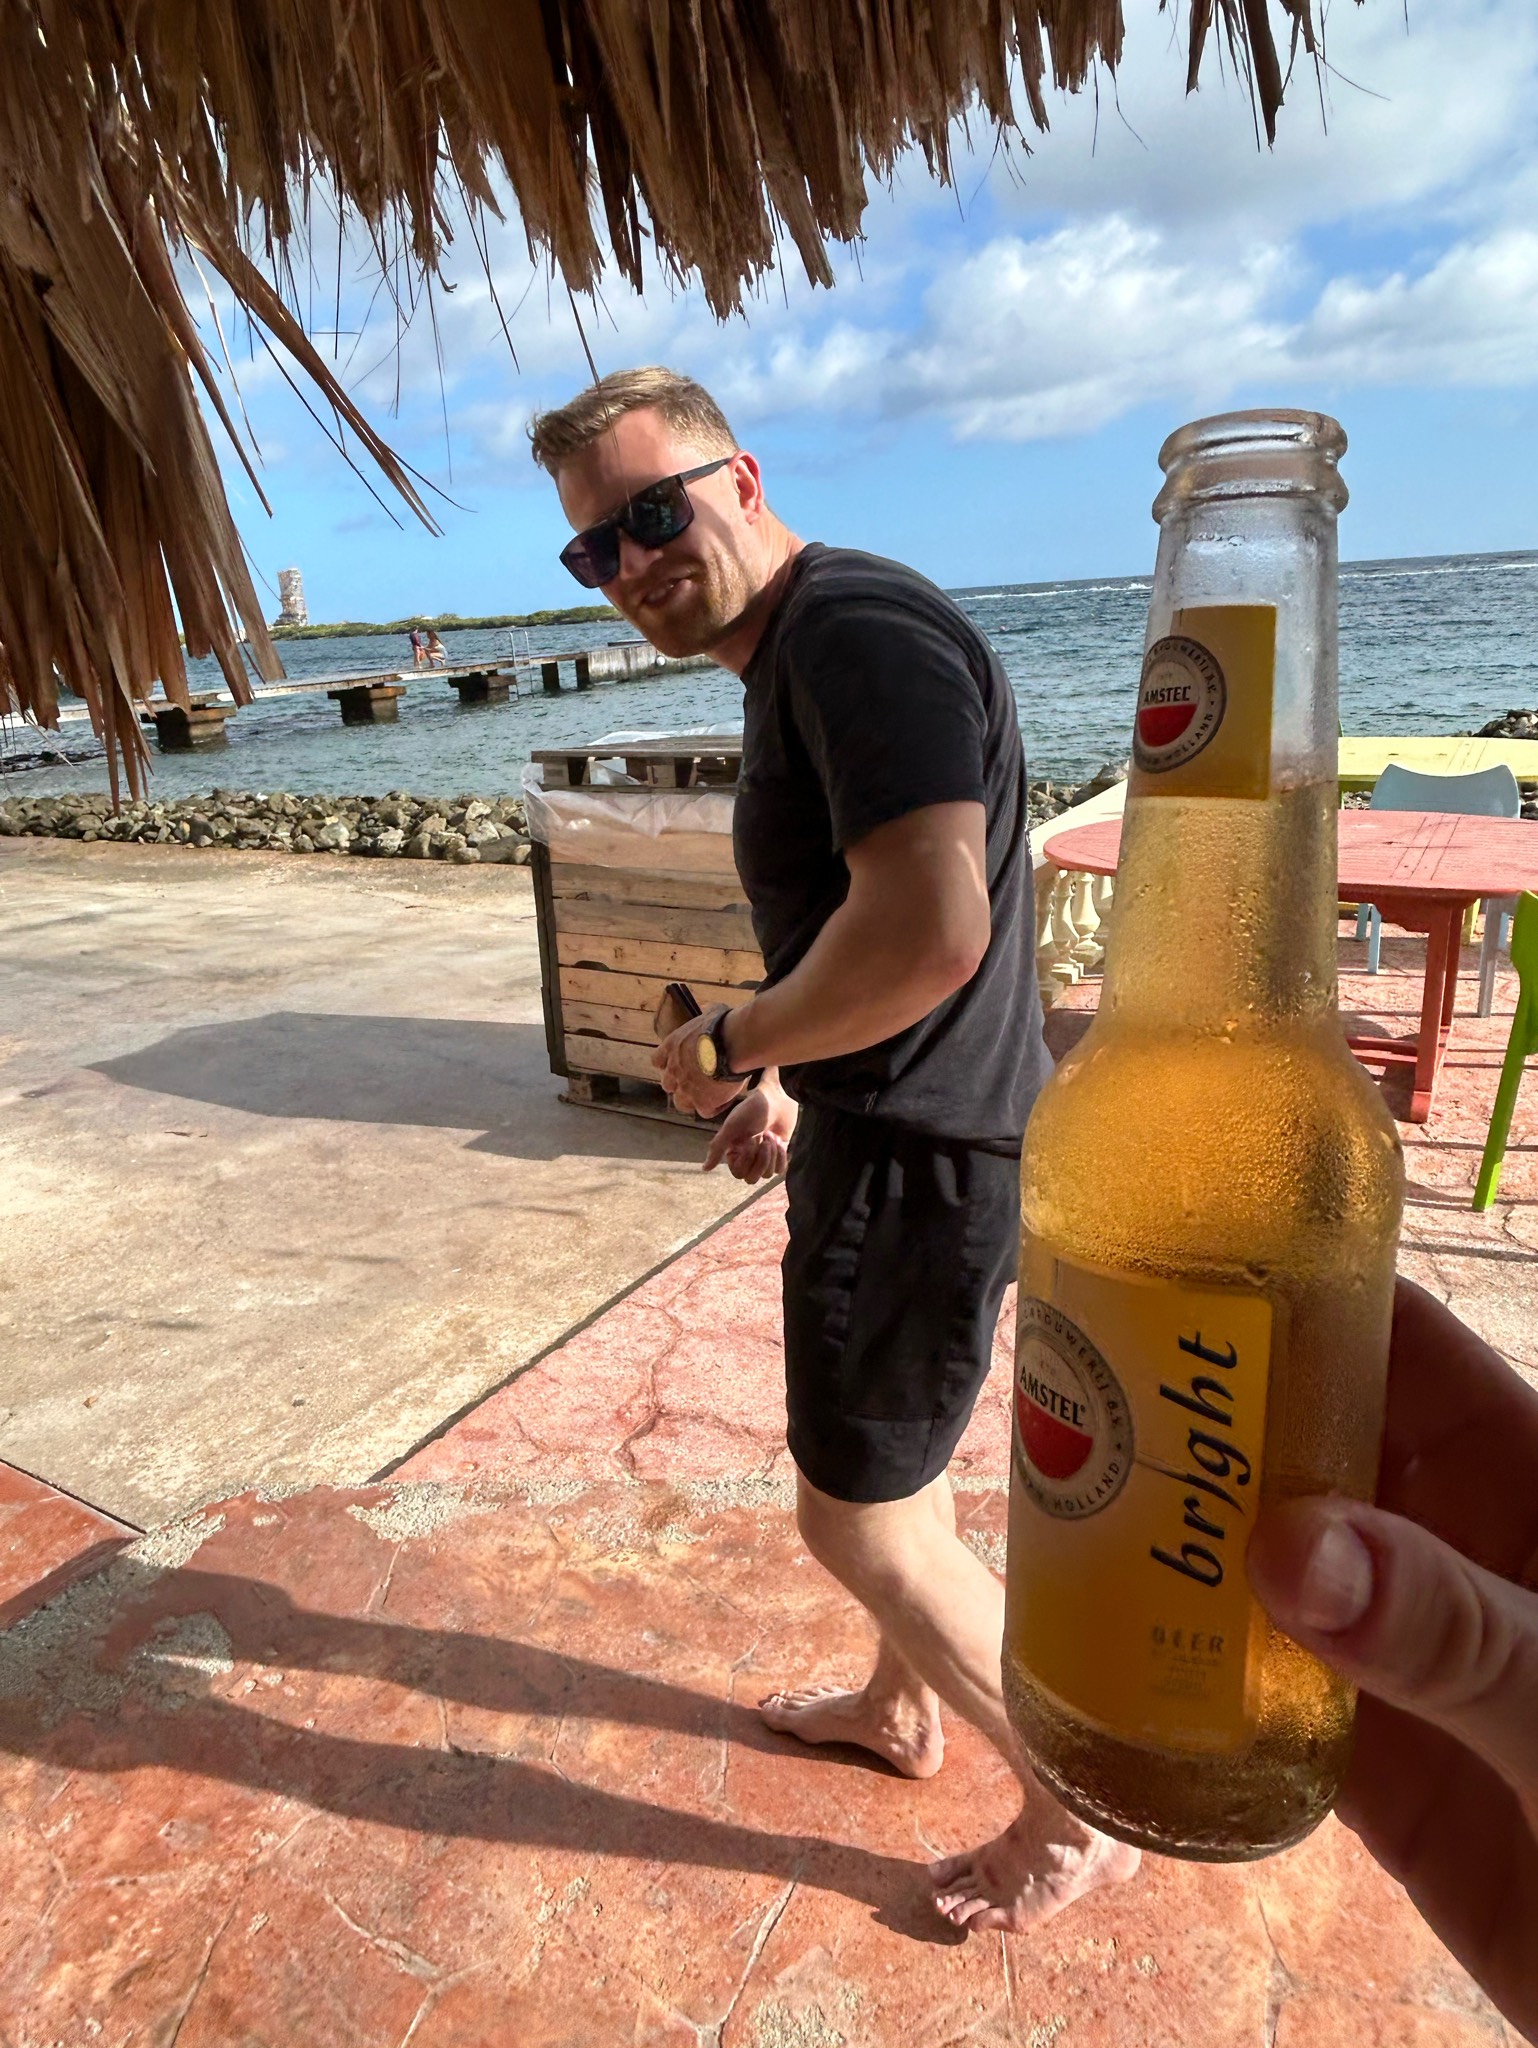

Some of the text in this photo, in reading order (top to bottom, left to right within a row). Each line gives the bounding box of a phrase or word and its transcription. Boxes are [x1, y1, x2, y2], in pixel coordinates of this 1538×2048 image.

[1144, 685, 1191, 703] AMSTEL
[1151, 1331, 1250, 1587] bright
[1054, 1463, 1120, 1511] HOLLAND
